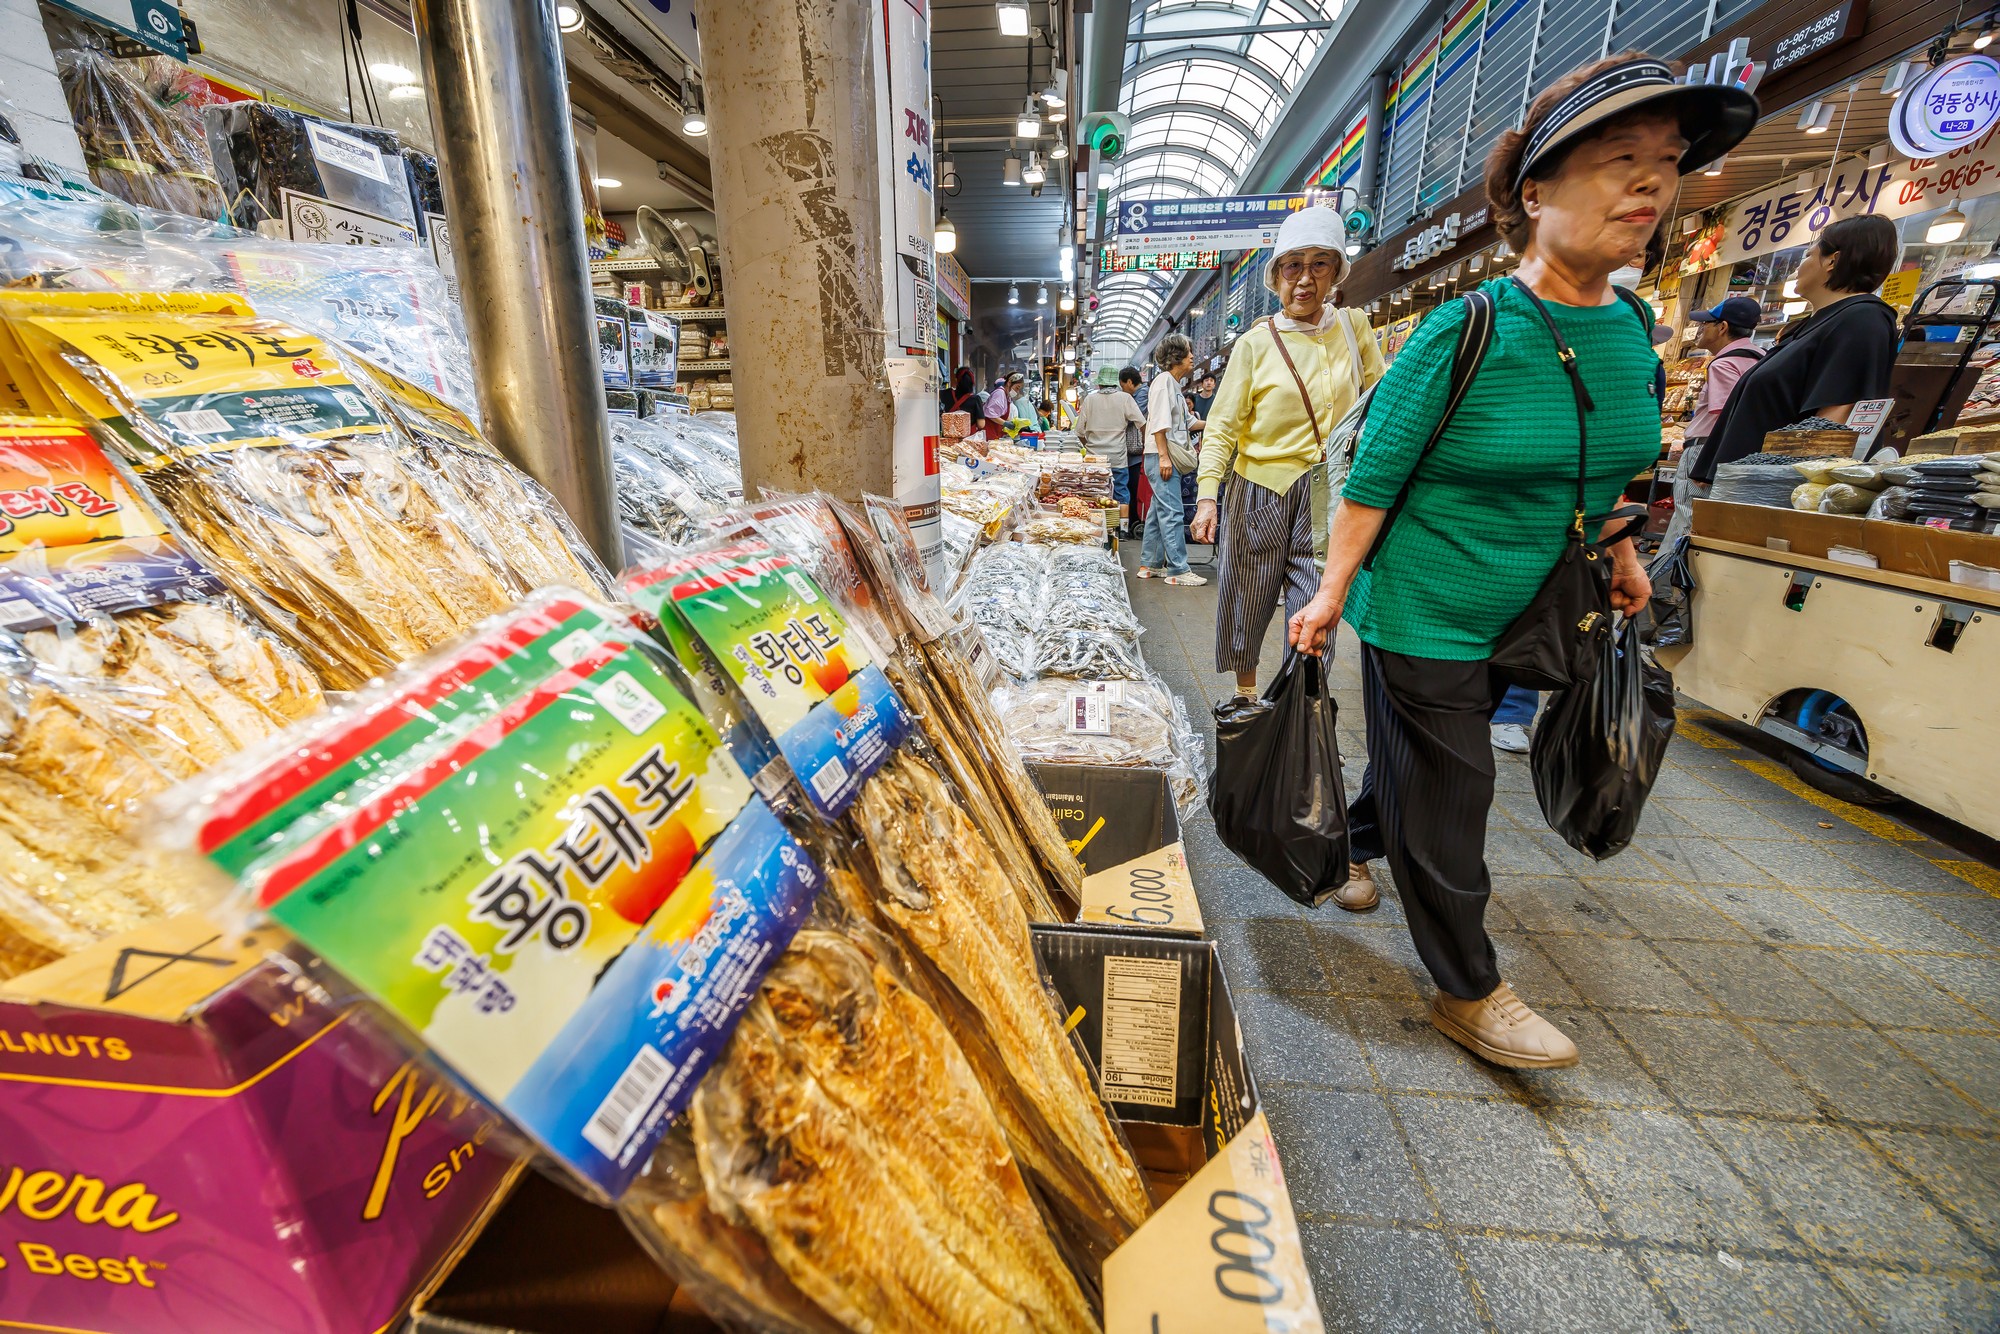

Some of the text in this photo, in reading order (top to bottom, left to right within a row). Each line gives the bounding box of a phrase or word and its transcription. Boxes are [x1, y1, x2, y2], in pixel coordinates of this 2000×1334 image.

[1773, 27, 1836, 70] 02-966-7585
[1777, 10, 1840, 54] 02-967-8263
[1929, 90, 1998, 115] 경동상사
[1946, 121, 1969, 131] 나-28
[1899, 159, 2000, 205] 02-966-
[1153, 197, 1308, 214] 온라인 마케팅으로 우리 가게 매출 UP!
[1737, 163, 1893, 251] 경동상사
[126, 330, 313, 371] 황태포
[0, 482, 119, 536] 태포
[734, 645, 777, 698] 대관령
[752, 614, 840, 686] 황태포
[1076, 794, 1084, 803] To
[478, 749, 695, 950] 황태포
[1106, 868, 1174, 925] 6,000
[415, 926, 516, 1012] 대관령
[0, 1032, 132, 1061] LNUTS
[1106, 1073, 1173, 1085] Calories 190
[1132, 1095, 1172, 1104] Nutrition
